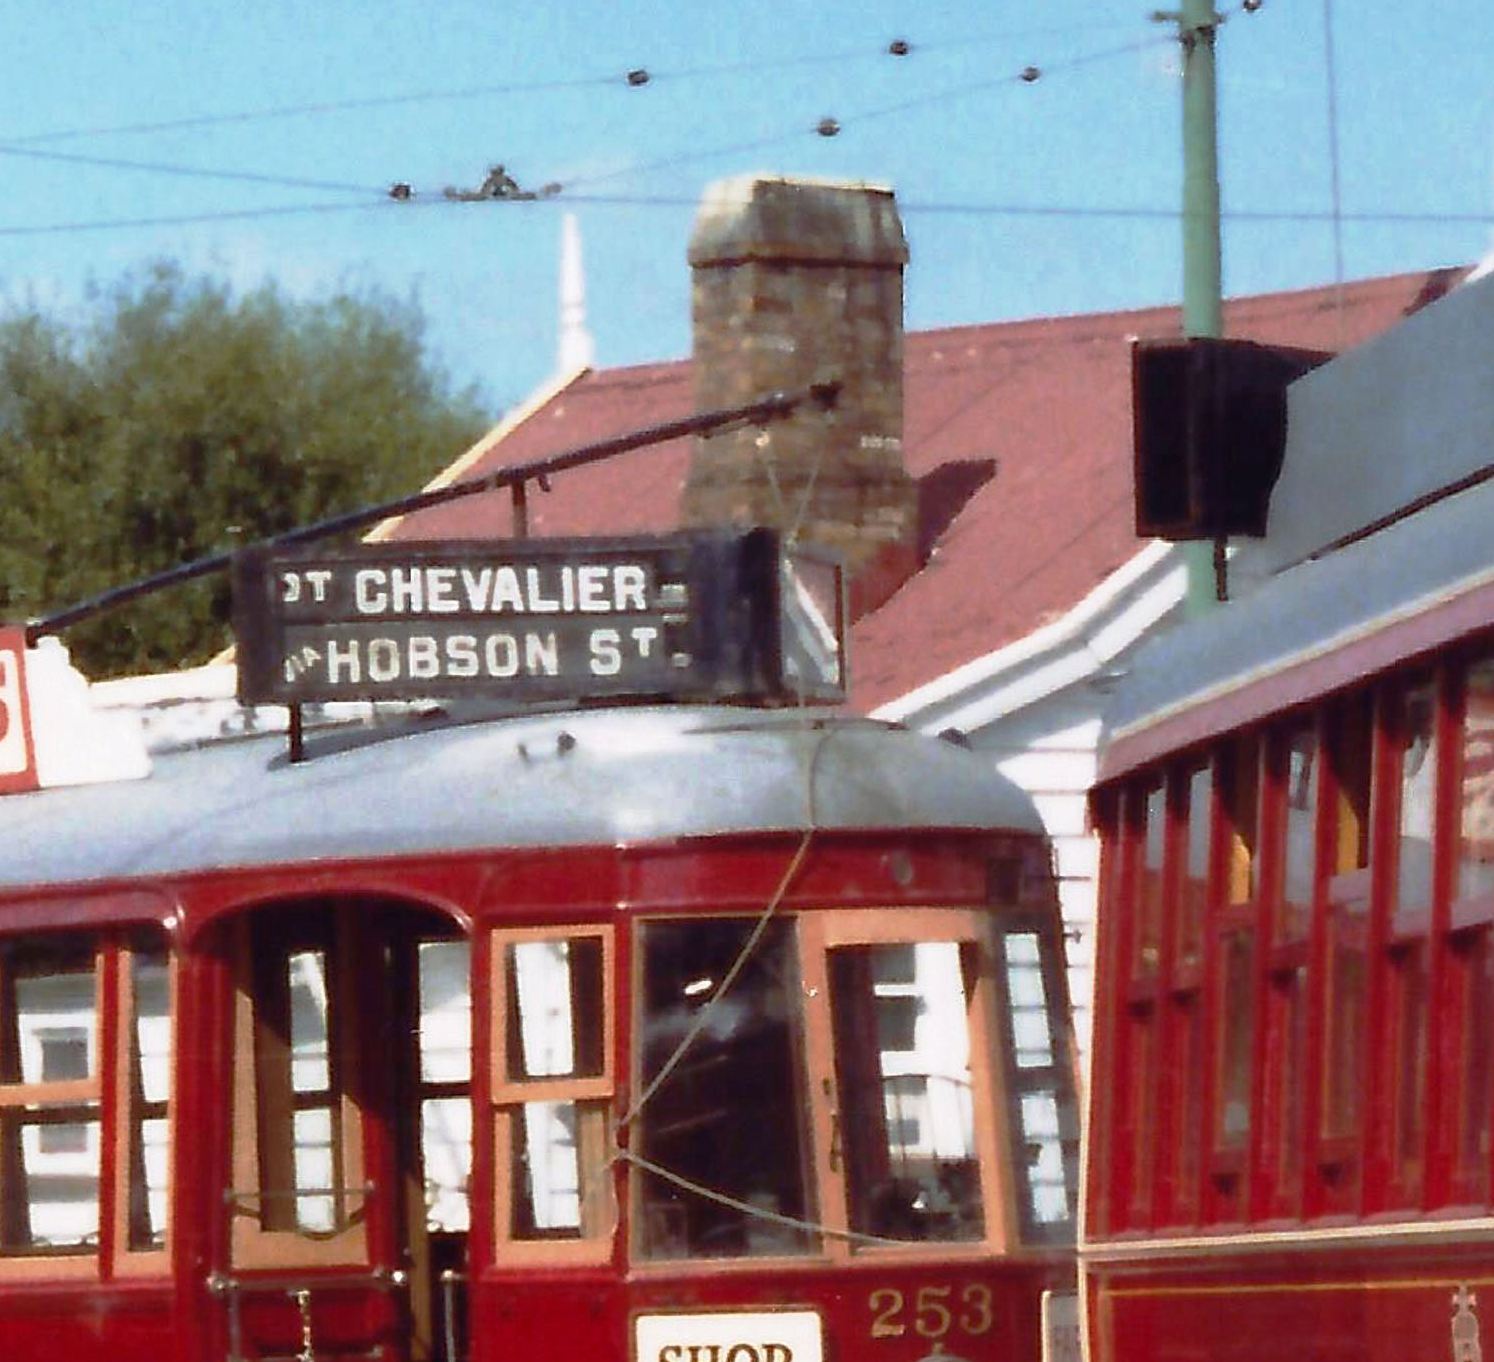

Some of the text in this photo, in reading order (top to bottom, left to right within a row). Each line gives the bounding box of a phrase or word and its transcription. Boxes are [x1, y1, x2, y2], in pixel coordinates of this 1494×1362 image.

[354, 565, 647, 615] CHEVALIER
[326, 632, 560, 685] HOBSON
[589, 626, 658, 676] ST
[868, 1284, 994, 1338] 253
